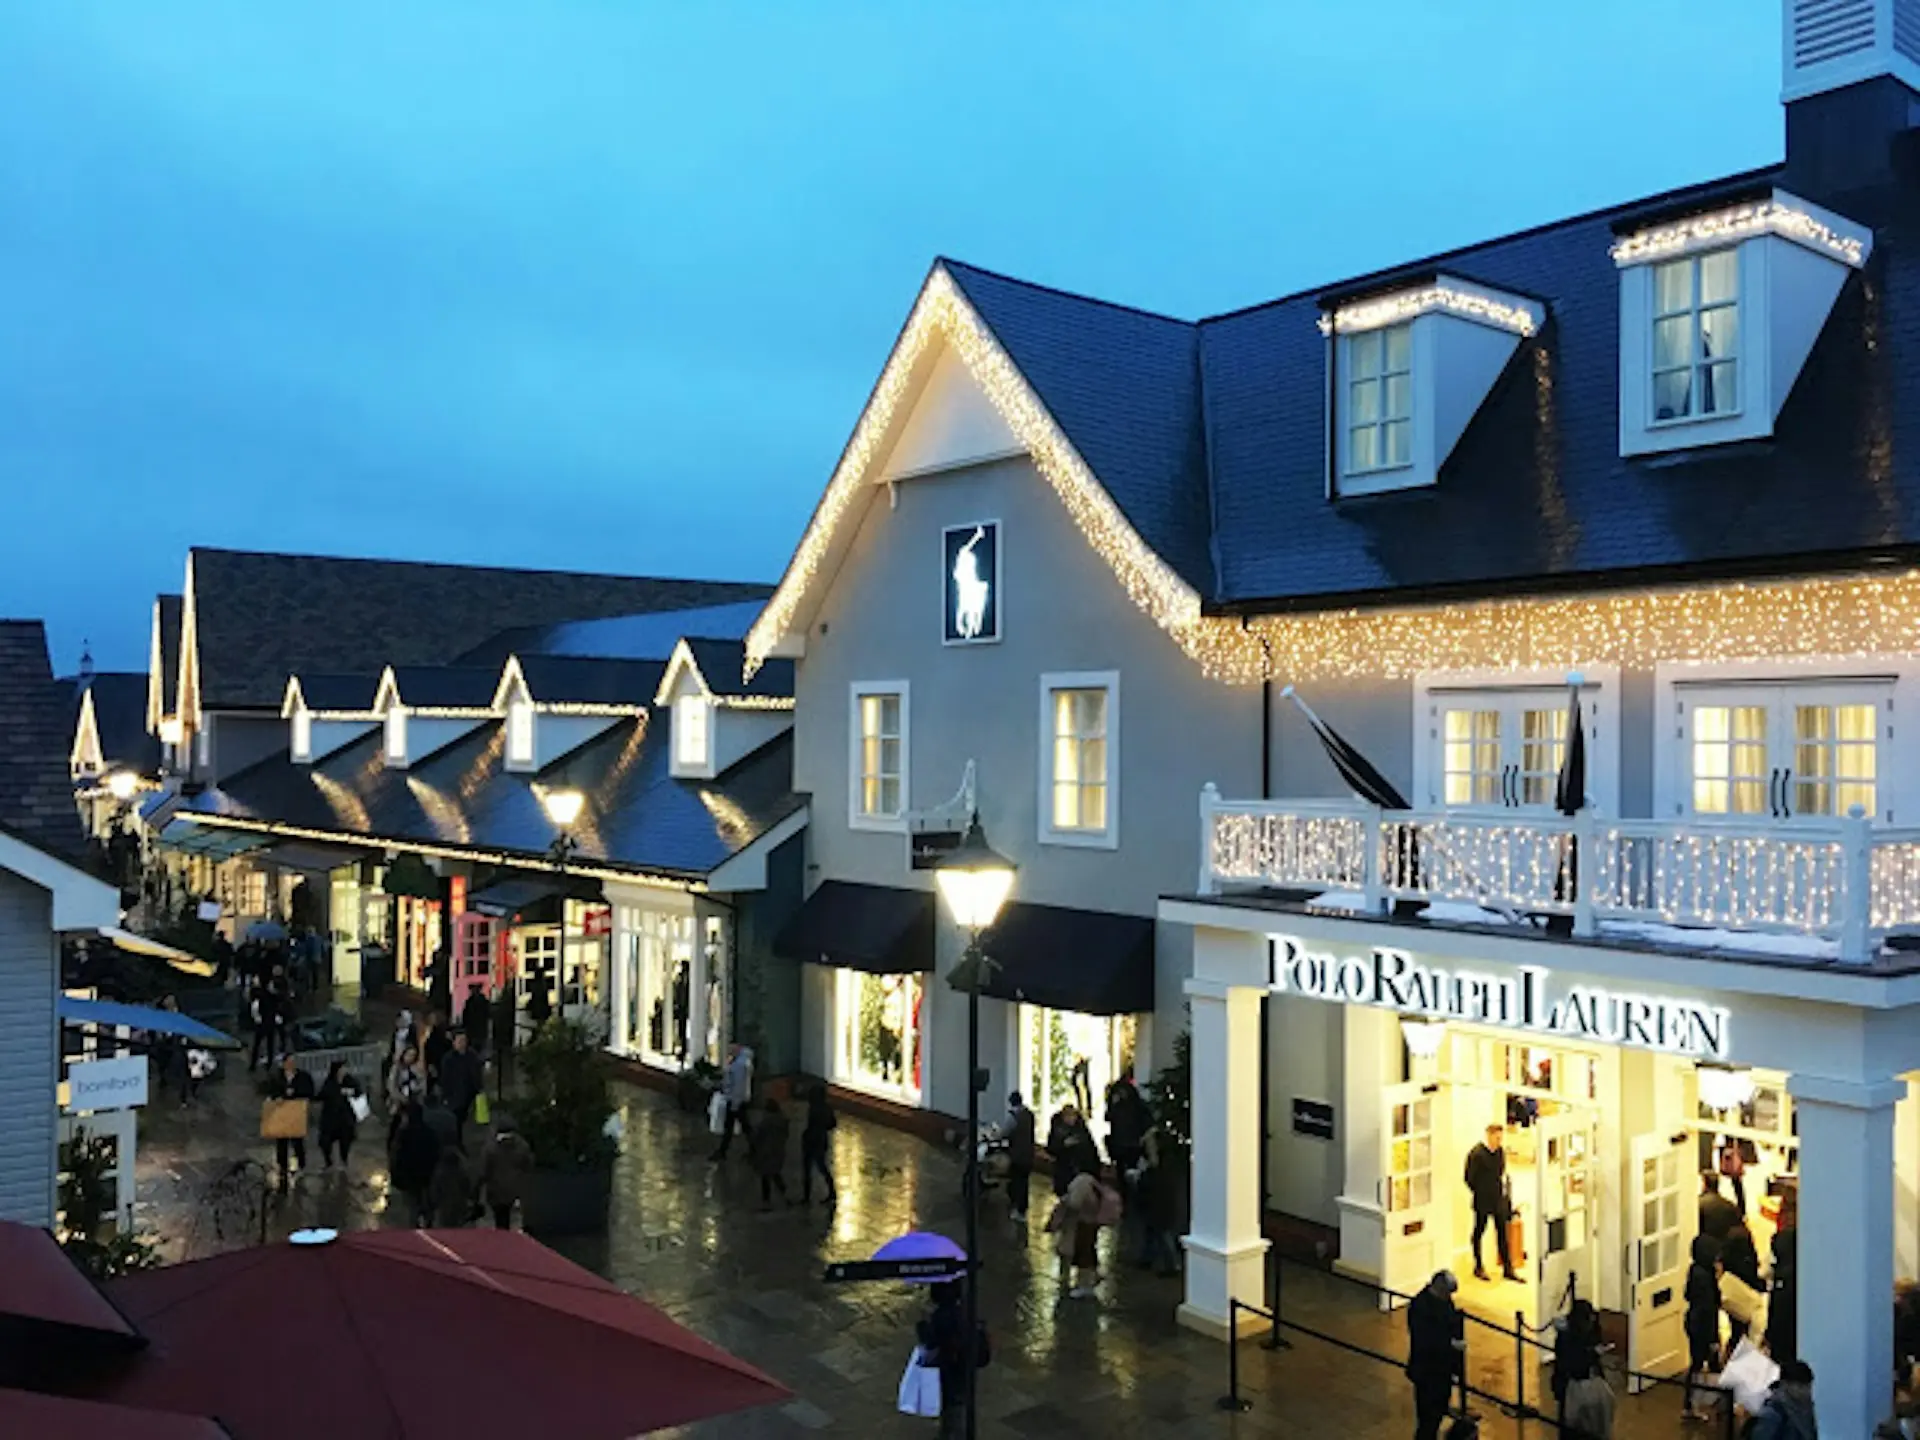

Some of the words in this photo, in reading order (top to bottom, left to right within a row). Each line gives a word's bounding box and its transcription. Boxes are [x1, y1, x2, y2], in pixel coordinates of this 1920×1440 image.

[1265, 935, 1366, 998] POLO
[1371, 948, 1513, 1022] RALPH
[1518, 965, 1730, 1057] LAUREN
